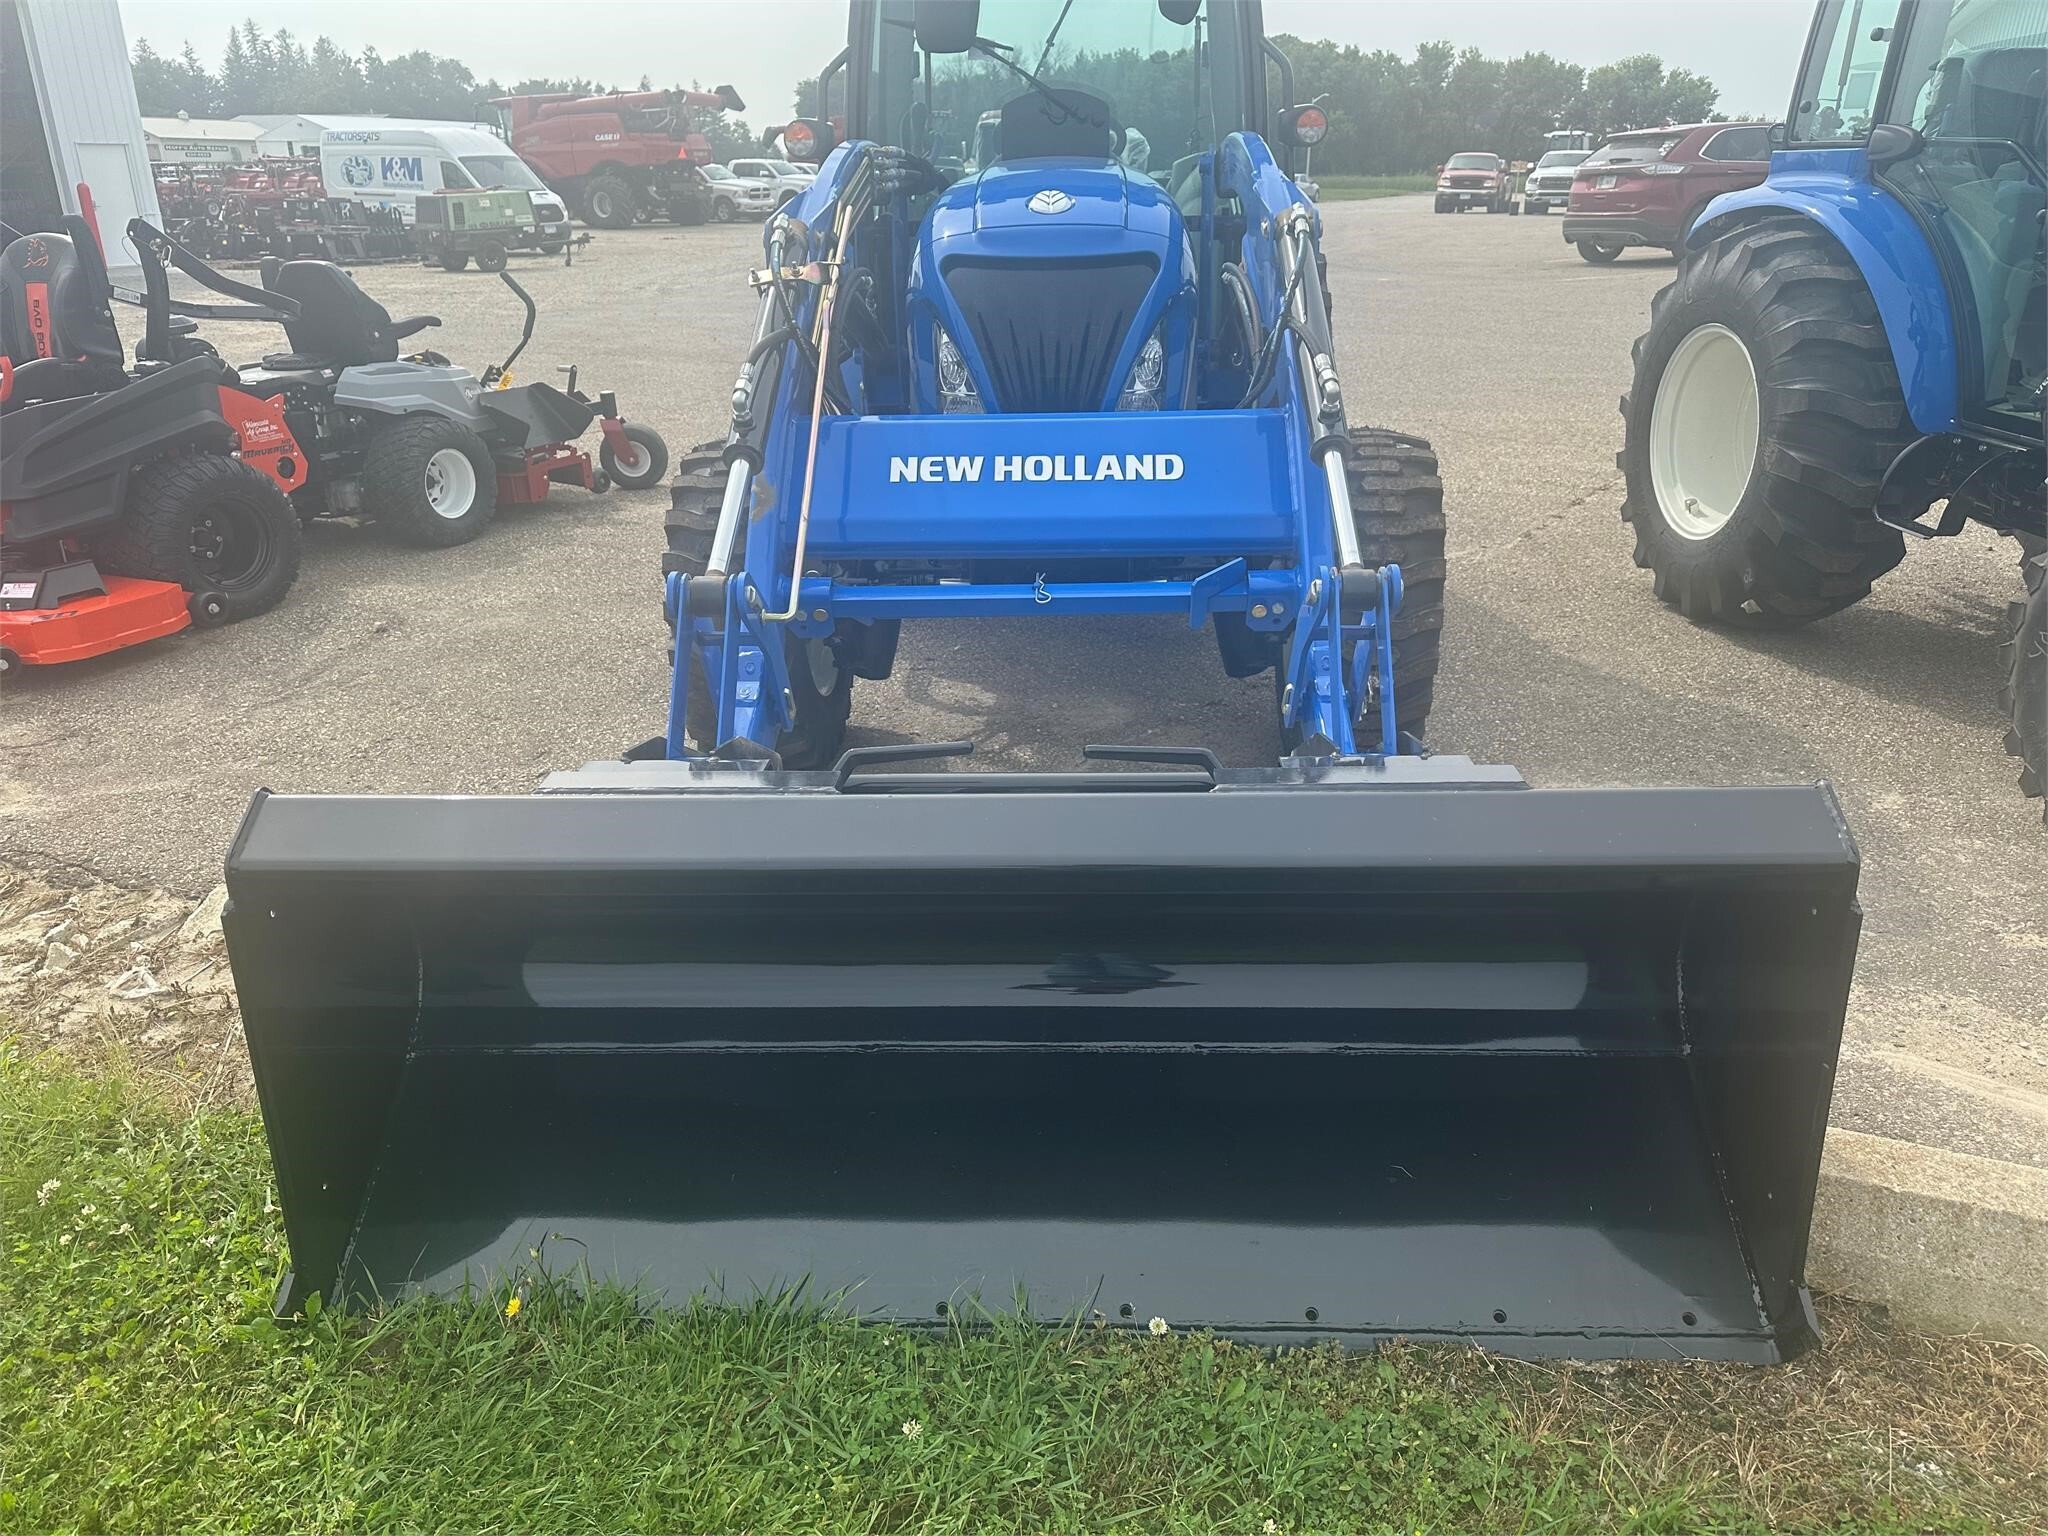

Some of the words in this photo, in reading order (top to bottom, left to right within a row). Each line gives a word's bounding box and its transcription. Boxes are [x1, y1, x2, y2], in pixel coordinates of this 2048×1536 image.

[594, 133, 613, 141] CASE
[380, 157, 423, 182] K&M
[33, 299, 43, 328] BAD
[889, 456, 984, 482] NEW
[994, 454, 1184, 481] HOLLAND
